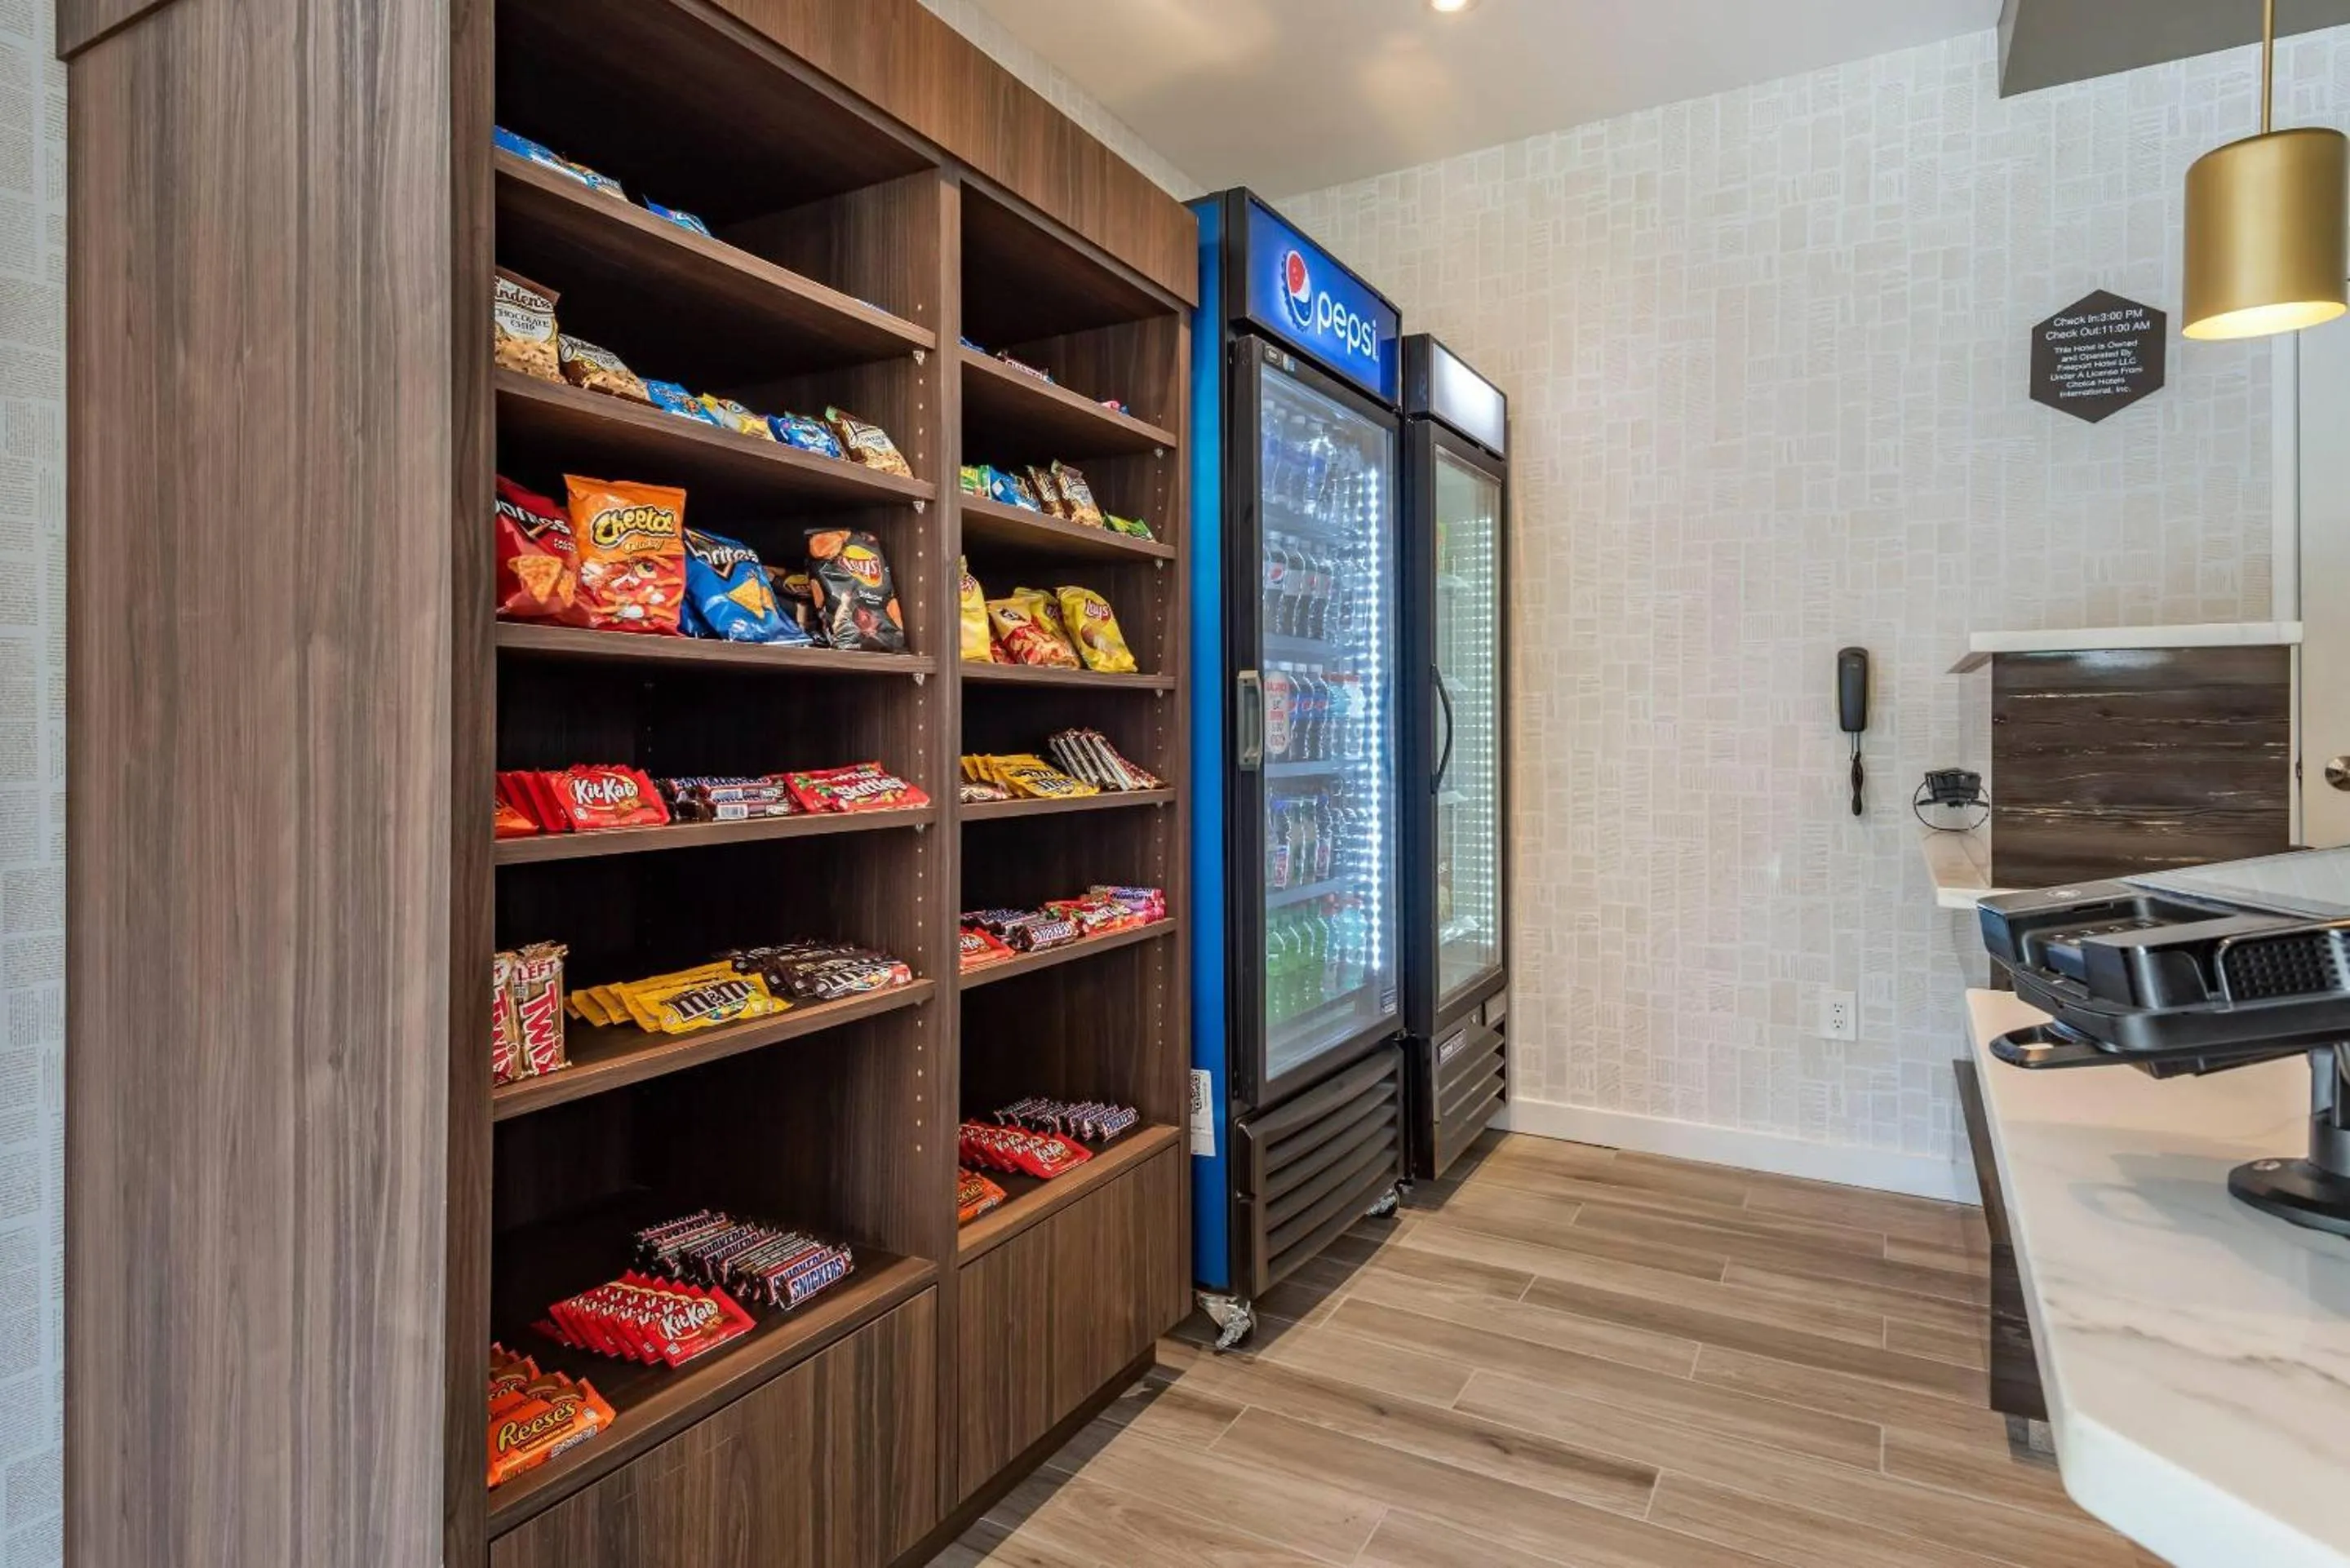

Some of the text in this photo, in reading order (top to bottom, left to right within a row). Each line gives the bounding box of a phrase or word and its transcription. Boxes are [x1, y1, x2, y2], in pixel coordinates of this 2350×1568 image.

[495, 288, 552, 309] nden's
[1317, 291, 1377, 361] pepsi
[2054, 317, 2085, 326] Check
[2126, 308, 2143, 319] PM
[2046, 329, 2077, 341] Check
[2132, 321, 2151, 331] AM
[2119, 357, 2136, 365] LLC
[574, 777, 636, 804] KitKat
[791, 1257, 844, 1300] SNICKERS
[662, 1301, 715, 1340] KitKat
[498, 1402, 576, 1454] Reese's
